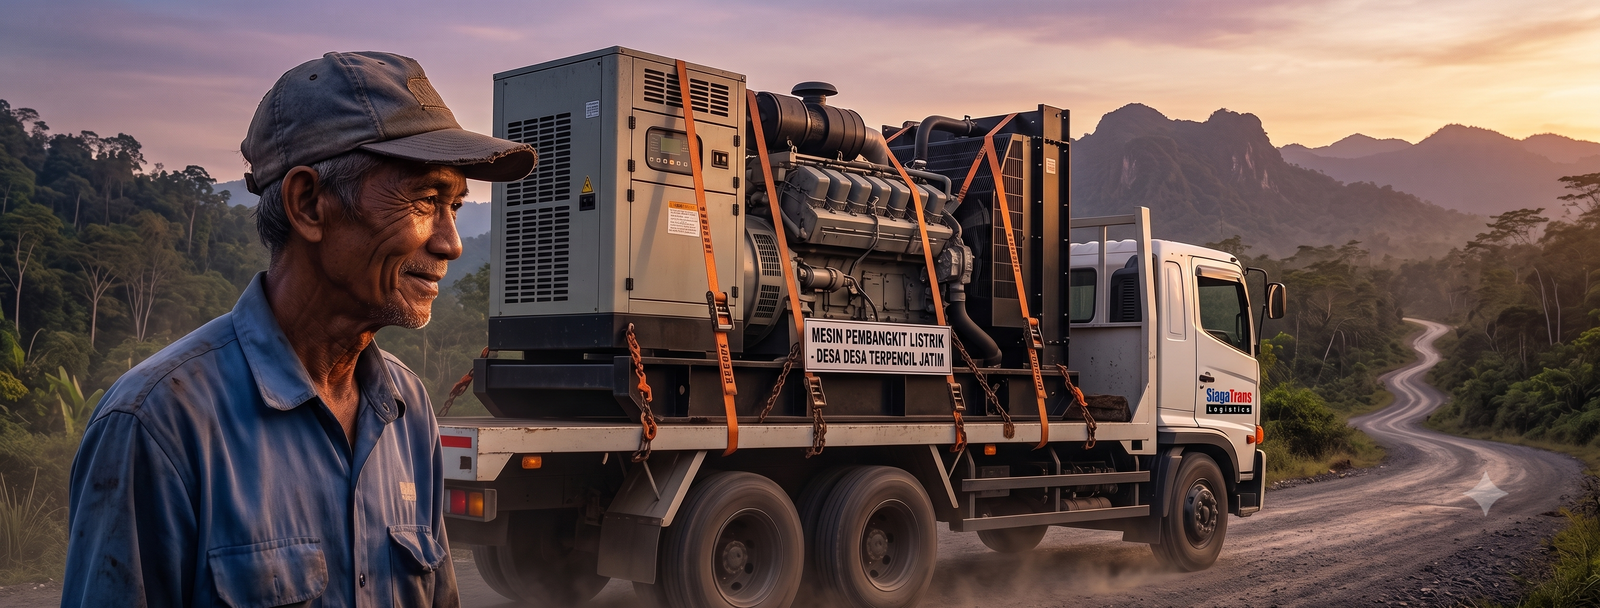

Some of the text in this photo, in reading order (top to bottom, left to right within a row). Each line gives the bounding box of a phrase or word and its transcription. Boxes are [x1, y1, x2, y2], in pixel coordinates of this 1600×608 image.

[812, 327, 945, 348] MESIN PEMBANGKIT LISTRIK
[817, 348, 841, 363] DESA
[844, 349, 867, 364] DESA
[869, 350, 917, 366] TERPENCIL
[919, 352, 945, 367] JATIM
[1206, 388, 1252, 404] SiagaTrans
[1208, 406, 1250, 414] Logistics
